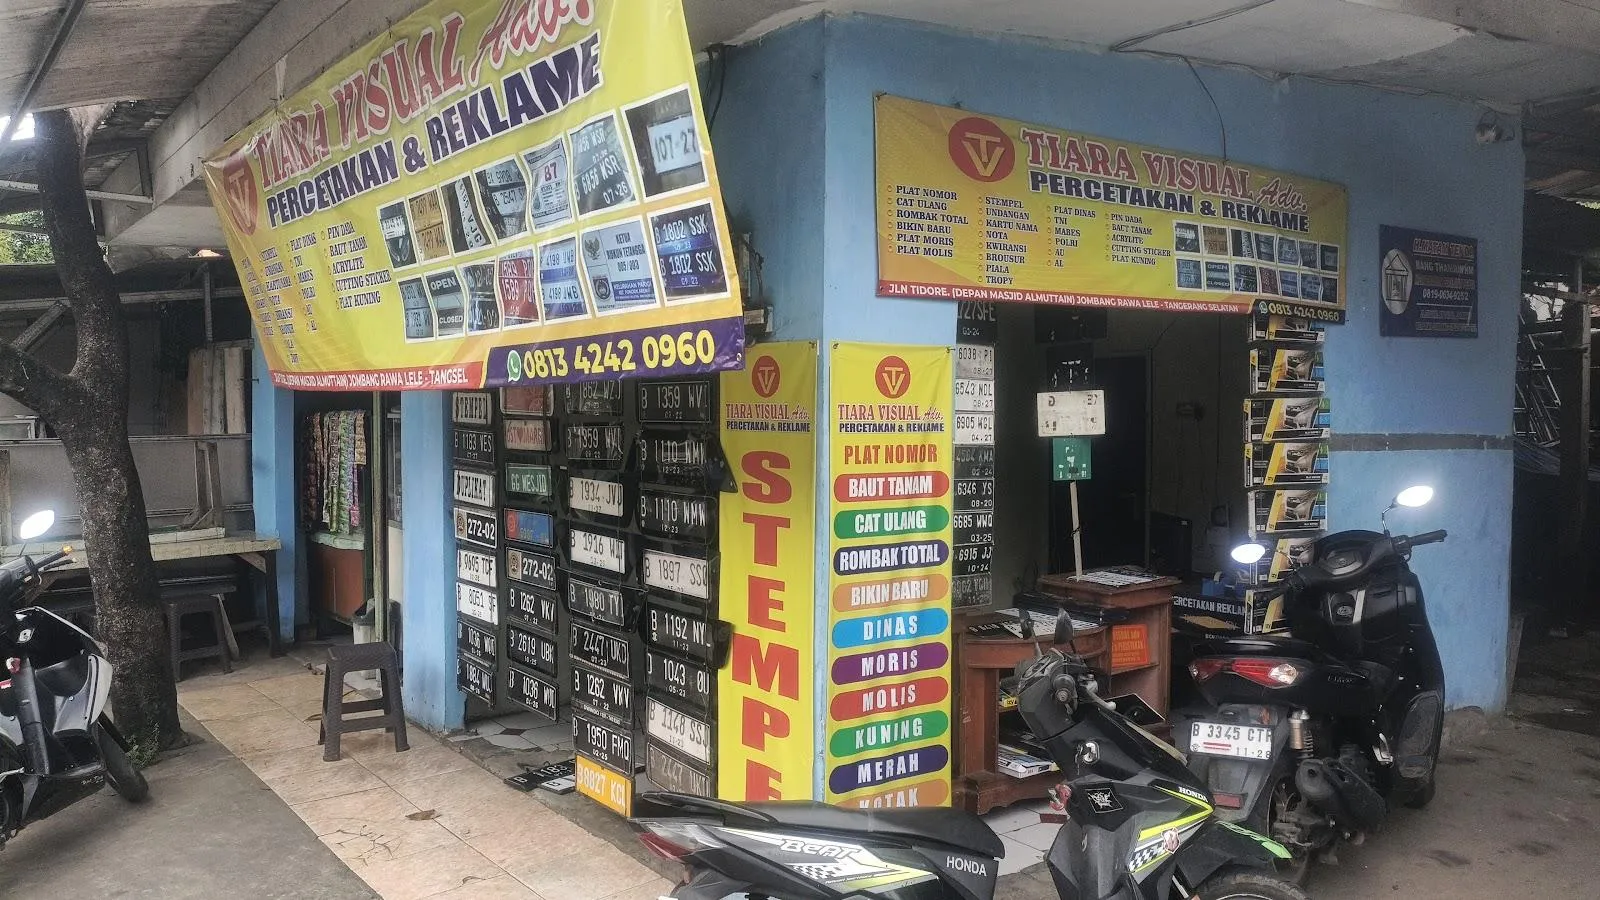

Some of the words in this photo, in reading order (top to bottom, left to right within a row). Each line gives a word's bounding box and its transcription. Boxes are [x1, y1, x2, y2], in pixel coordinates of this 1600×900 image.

[255, 103, 330, 188] TIARA
[331, 13, 465, 148] VISUAL
[267, 139, 400, 228] PERCETAKAN
[403, 135, 427, 175] &
[425, 30, 602, 162] REKLAME
[544, 161, 558, 182] 87
[1021, 128, 1137, 182] TIARA
[1140, 150, 1254, 202] VISUAL
[896, 185, 921, 196] PLAT
[922, 188, 958, 200] NOMOR
[985, 197, 1024, 209] STEMPEL
[1029, 170, 1195, 213] PERCETAKAN
[1200, 200, 1216, 217] &
[1222, 199, 1310, 232] REKLAME
[896, 197, 913, 207] CAT
[917, 199, 947, 211] ULANG
[985, 208, 1030, 220] UNDANGAN
[1054, 206, 1073, 216] PLAT
[1074, 208, 1096, 219] DINAS
[663, 220, 686, 242] 1802
[689, 213, 708, 236] SSK
[896, 209, 938, 221] ROMBAK
[941, 214, 969, 225] TOTAL
[985, 219, 1015, 230] KARTU
[1016, 222, 1039, 233] NAMA
[1054, 216, 1067, 225] TNI
[327, 226, 341, 239] PIN
[896, 222, 925, 233] BIKIN
[927, 224, 951, 235] BARU
[985, 231, 1008, 240] NOTA
[1054, 227, 1081, 237] MABES
[896, 234, 921, 244] PLAT
[923, 236, 954, 247] MORIS
[1055, 238, 1078, 247] POLRI
[669, 254, 693, 275] 1802
[696, 250, 717, 272] SSK
[896, 246, 922, 255] PLAT
[923, 247, 953, 258] MOLIS
[985, 254, 1025, 264] BROUSUR
[1055, 249, 1065, 257] AU
[332, 257, 364, 274] ACRYLITE
[985, 264, 1010, 273] PIALA
[430, 277, 457, 290] OPEN
[985, 275, 1014, 285] TROPY
[354, 291, 381, 307] KUNING
[889, 283, 908, 294] JLN
[909, 285, 950, 296] TIDORE.
[952, 287, 988, 299] (DEPAN
[989, 289, 1023, 301] MASJID
[1025, 292, 1076, 306] ALMUTTAIN)
[1077, 295, 1115, 307] JOMBANG
[1117, 298, 1142, 308] RAWA
[1142, 299, 1159, 308] LELE
[1164, 300, 1208, 312] TANGERANG
[1209, 302, 1239, 313] SELATAN
[439, 315, 464, 324] CLOSED
[1269, 301, 1292, 314] 0813
[1293, 304, 1318, 319] 4242
[1318, 306, 1340, 321] 0960
[524, 347, 568, 379] 0813
[574, 339, 637, 374] 4242
[641, 329, 715, 369] 0960
[380, 372, 403, 386] RAWA
[405, 371, 423, 385] LELE
[429, 368, 468, 384] TANGSEL
[657, 385, 681, 409] 1359
[955, 381, 976, 395] 6543
[725, 403, 753, 419] TIARA
[755, 404, 790, 420] VISUAL
[838, 404, 875, 421] TIARA
[878, 404, 921, 421] VISUAL
[726, 421, 770, 431] PERCETAKAN
[778, 422, 811, 432] REKLAME
[839, 422, 896, 433] PERCETAKAN
[898, 424, 903, 433] &
[906, 422, 945, 432] REKLAME
[956, 416, 975, 430] 6905
[655, 440, 678, 463] 1110
[844, 445, 882, 465] PLAT
[884, 444, 938, 464] NOMOR
[580, 481, 600, 502] 1934
[848, 477, 886, 498] BAUT
[887, 475, 933, 496] TANAM
[957, 482, 977, 496] 6346
[655, 497, 678, 522] 1110
[467, 518, 495, 540] 272-02
[661, 522, 679, 534] 12-23
[854, 512, 881, 534] CAT
[884, 510, 927, 531] ULANG
[953, 514, 973, 529] 6685
[583, 532, 604, 556] 1916
[959, 547, 978, 561] 6915
[839, 549, 899, 571] ROMBAK
[901, 544, 940, 565] TOTAL
[522, 558, 554, 582] 272-02
[658, 559, 681, 584] 1897
[521, 591, 535, 614] 1262
[584, 588, 605, 612] 1980
[851, 583, 890, 606] BIKIN
[892, 579, 929, 601] BARU
[664, 613, 688, 640] 1192
[863, 615, 918, 641] DINAS
[518, 633, 536, 656] 2619
[584, 631, 604, 657] 2447
[664, 658, 686, 686] 1043
[861, 650, 918, 677] MORIS
[523, 676, 539, 700] 1036
[587, 674, 605, 700] 1262
[862, 684, 917, 712] MOLIS
[662, 707, 686, 736] 1148
[1192, 723, 1200, 737] B
[1207, 725, 1241, 741] 3345
[587, 723, 608, 751] 1950
[612, 734, 630, 761] FMQ
[855, 717, 923, 749] KUNING
[857, 752, 919, 784] MERAH
[1178, 786, 1209, 803] HONDA
[947, 855, 987, 877] HONDA
